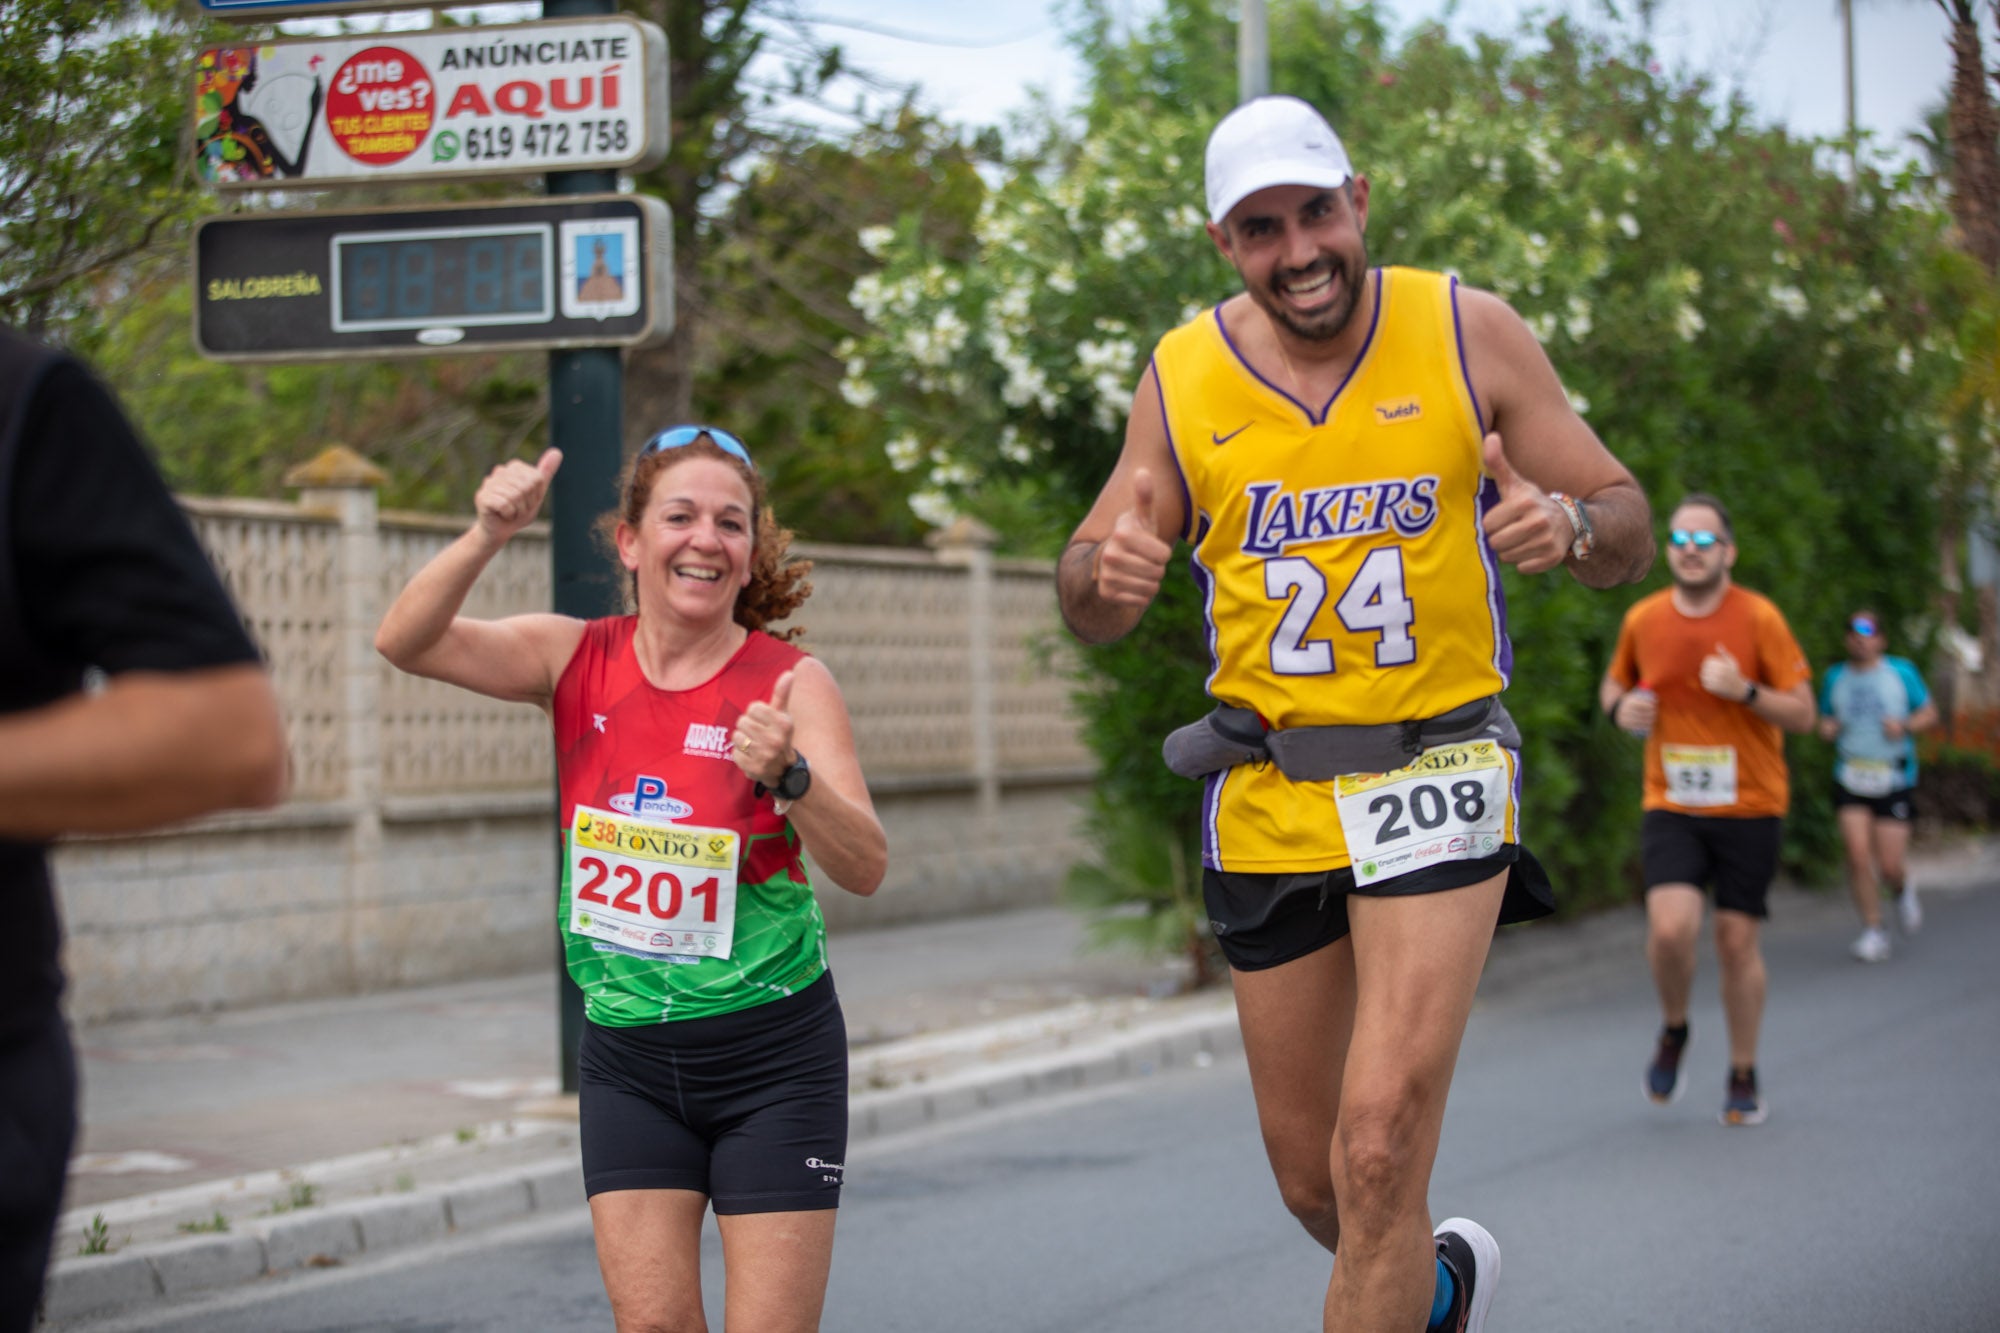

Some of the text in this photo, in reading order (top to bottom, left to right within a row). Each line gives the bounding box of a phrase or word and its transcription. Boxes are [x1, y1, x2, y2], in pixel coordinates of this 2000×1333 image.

[440, 37, 627, 71] ANÚNCIATE
[337, 59, 403, 94] ¿me
[445, 63, 621, 119] AQUÍ
[358, 80, 431, 111] ves?
[332, 111, 429, 135] TUS CLIENTES
[347, 134, 416, 155] TAMBIÉN
[466, 119, 628, 160] 619 472 758
[207, 271, 322, 302] SALOBREÑA
[1376, 402, 1420, 420] wish
[1240, 475, 1440, 556] LAKERS
[1264, 545, 1416, 675] 24
[1368, 780, 1486, 845] 208
[593, 821, 617, 843] 38
[617, 832, 698, 859] FONDO
[622, 824, 691, 842] GRAN PREMIO
[577, 857, 719, 923] 2201
